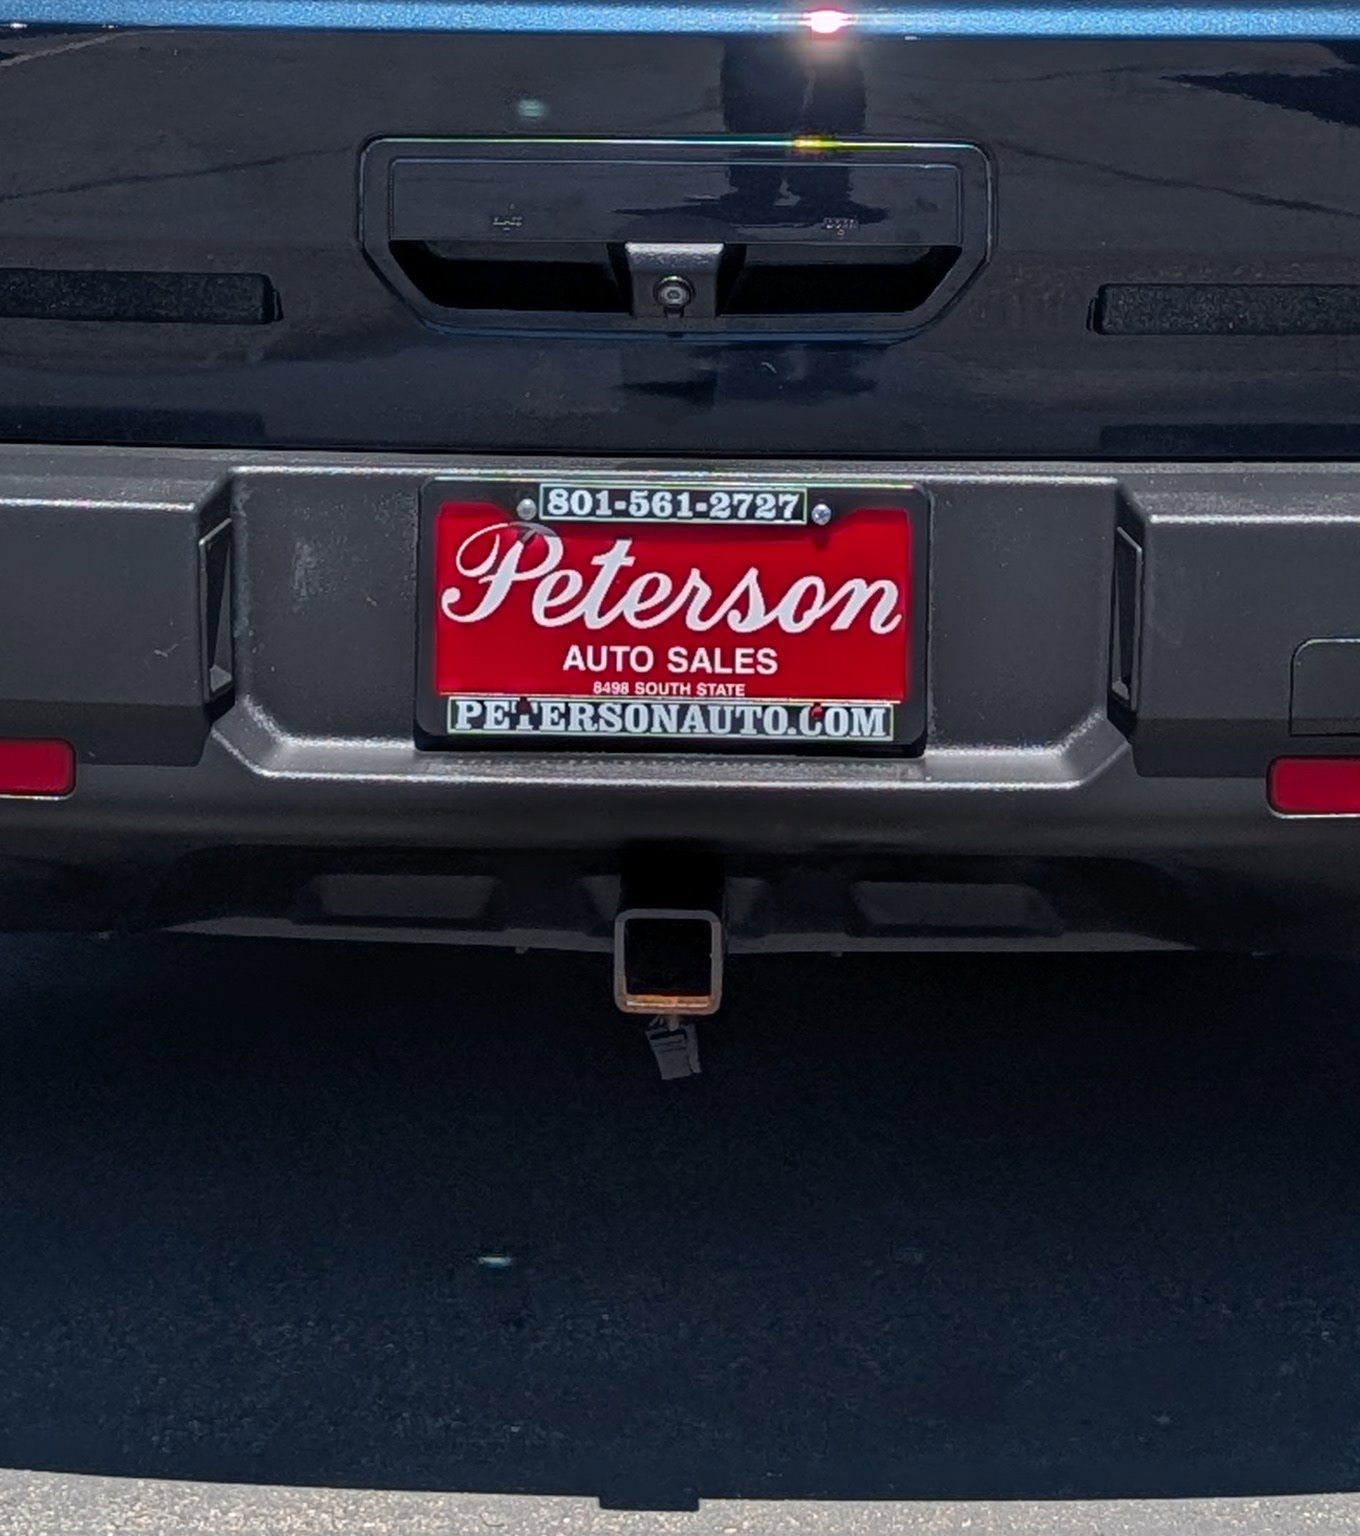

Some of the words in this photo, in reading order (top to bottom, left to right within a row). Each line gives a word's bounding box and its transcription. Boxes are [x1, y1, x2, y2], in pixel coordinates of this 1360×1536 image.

[546, 488, 800, 521] 801-561-2727
[440, 521, 903, 636] Peterson
[562, 645, 655, 673] AUTO
[667, 647, 779, 675] SALES
[592, 680, 631, 695] 8498
[634, 681, 691, 696] SOUTH
[696, 682, 746, 697] STATE
